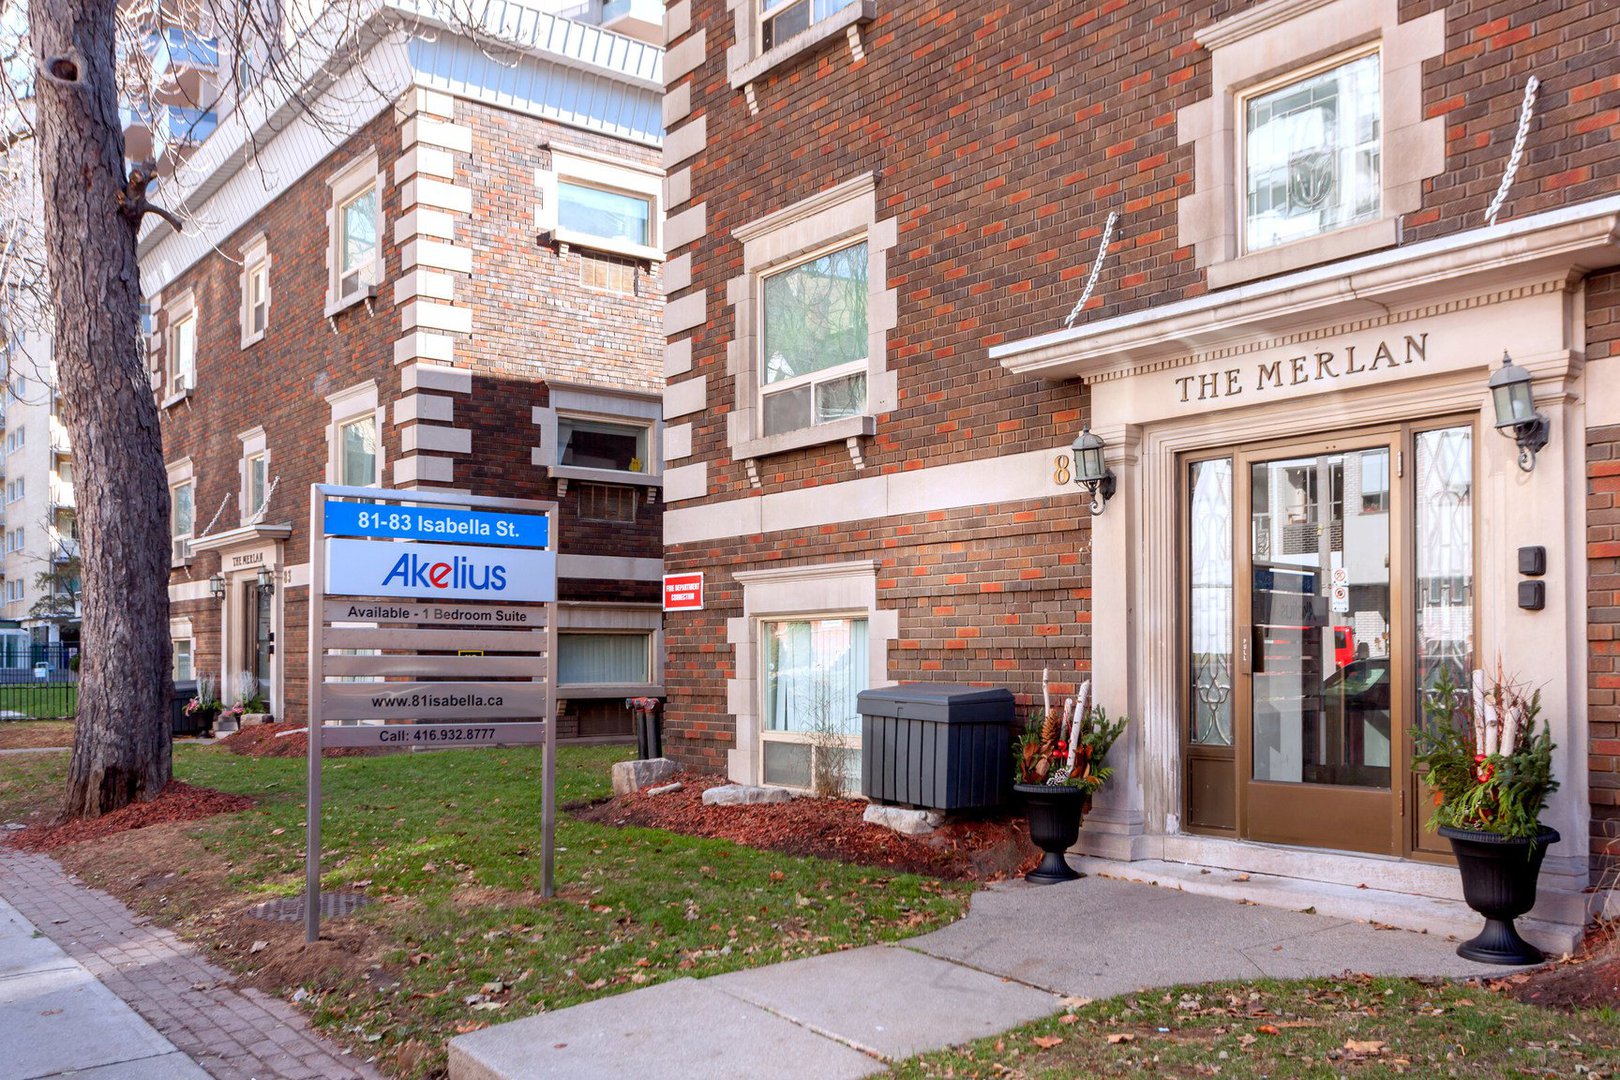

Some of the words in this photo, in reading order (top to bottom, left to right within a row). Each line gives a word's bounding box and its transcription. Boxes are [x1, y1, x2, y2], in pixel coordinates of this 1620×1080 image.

[1175, 368, 1242, 402] THE
[1256, 333, 1428, 390] MERLAN
[358, 512, 412, 531] 81-83
[418, 515, 490, 536] Isabella
[496, 520, 520, 538] St.
[232, 556, 242, 566] THE
[242, 552, 263, 564] MERLAN
[284, 570, 292, 584] 83
[381, 552, 507, 591] Akelius
[348, 606, 410, 619] Available
[423, 608, 429, 619] 1
[434, 608, 492, 621] Bedroom
[495, 610, 527, 622] Suite
[372, 694, 503, 708] www.81isabella.ca
[379, 730, 410, 743] Call:
[413, 728, 496, 742] 416.932.8777
